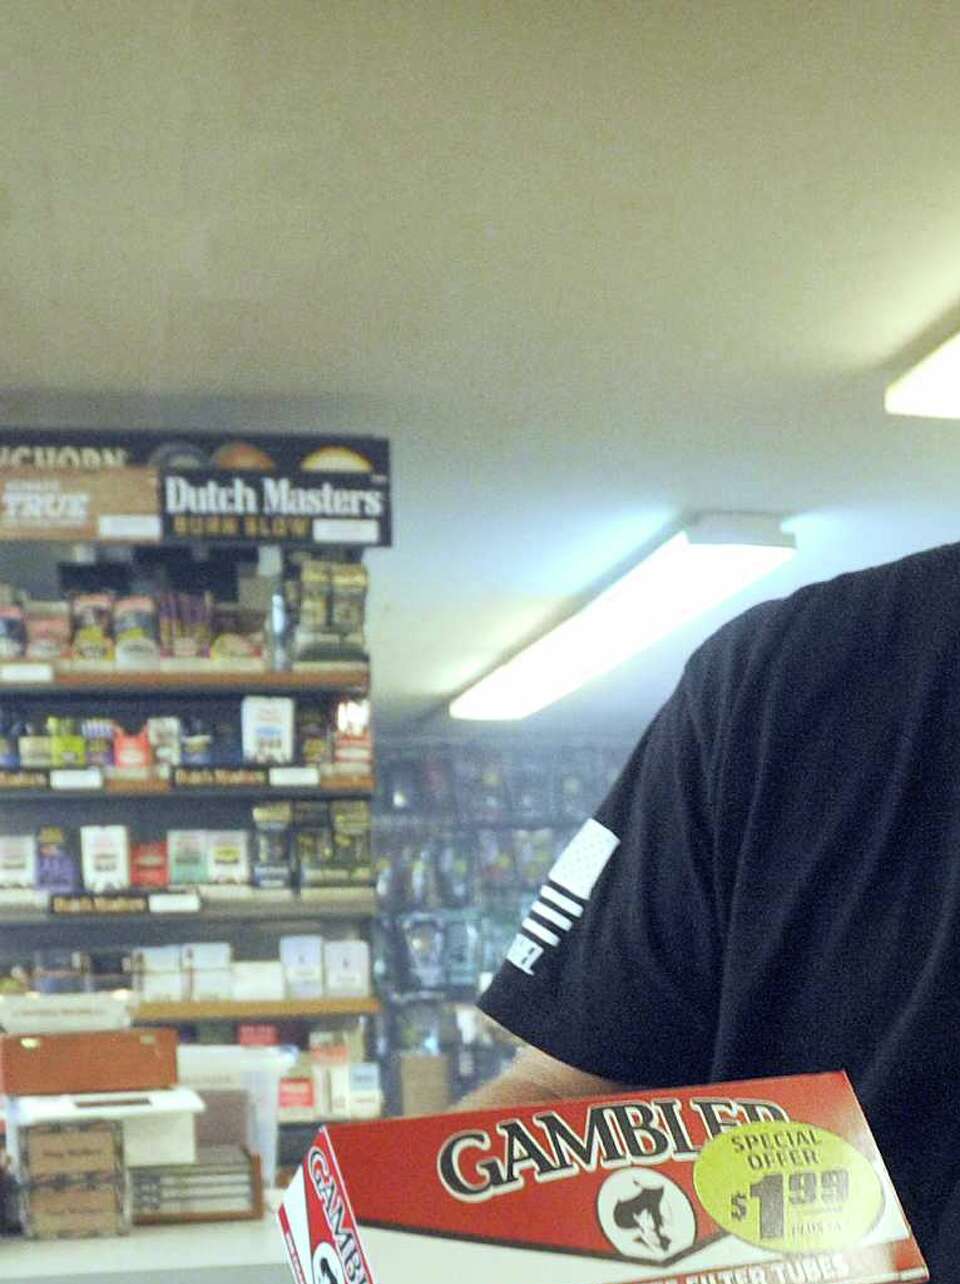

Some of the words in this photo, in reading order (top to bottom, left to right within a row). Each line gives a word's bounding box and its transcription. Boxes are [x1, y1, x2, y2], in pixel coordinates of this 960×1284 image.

[165, 476, 257, 515] Dutch
[263, 477, 383, 516] Masters
[731, 1129, 823, 1154] SPECIAL
[747, 1147, 820, 1171] OFFER
[768, 1254, 850, 1283] TUBES
